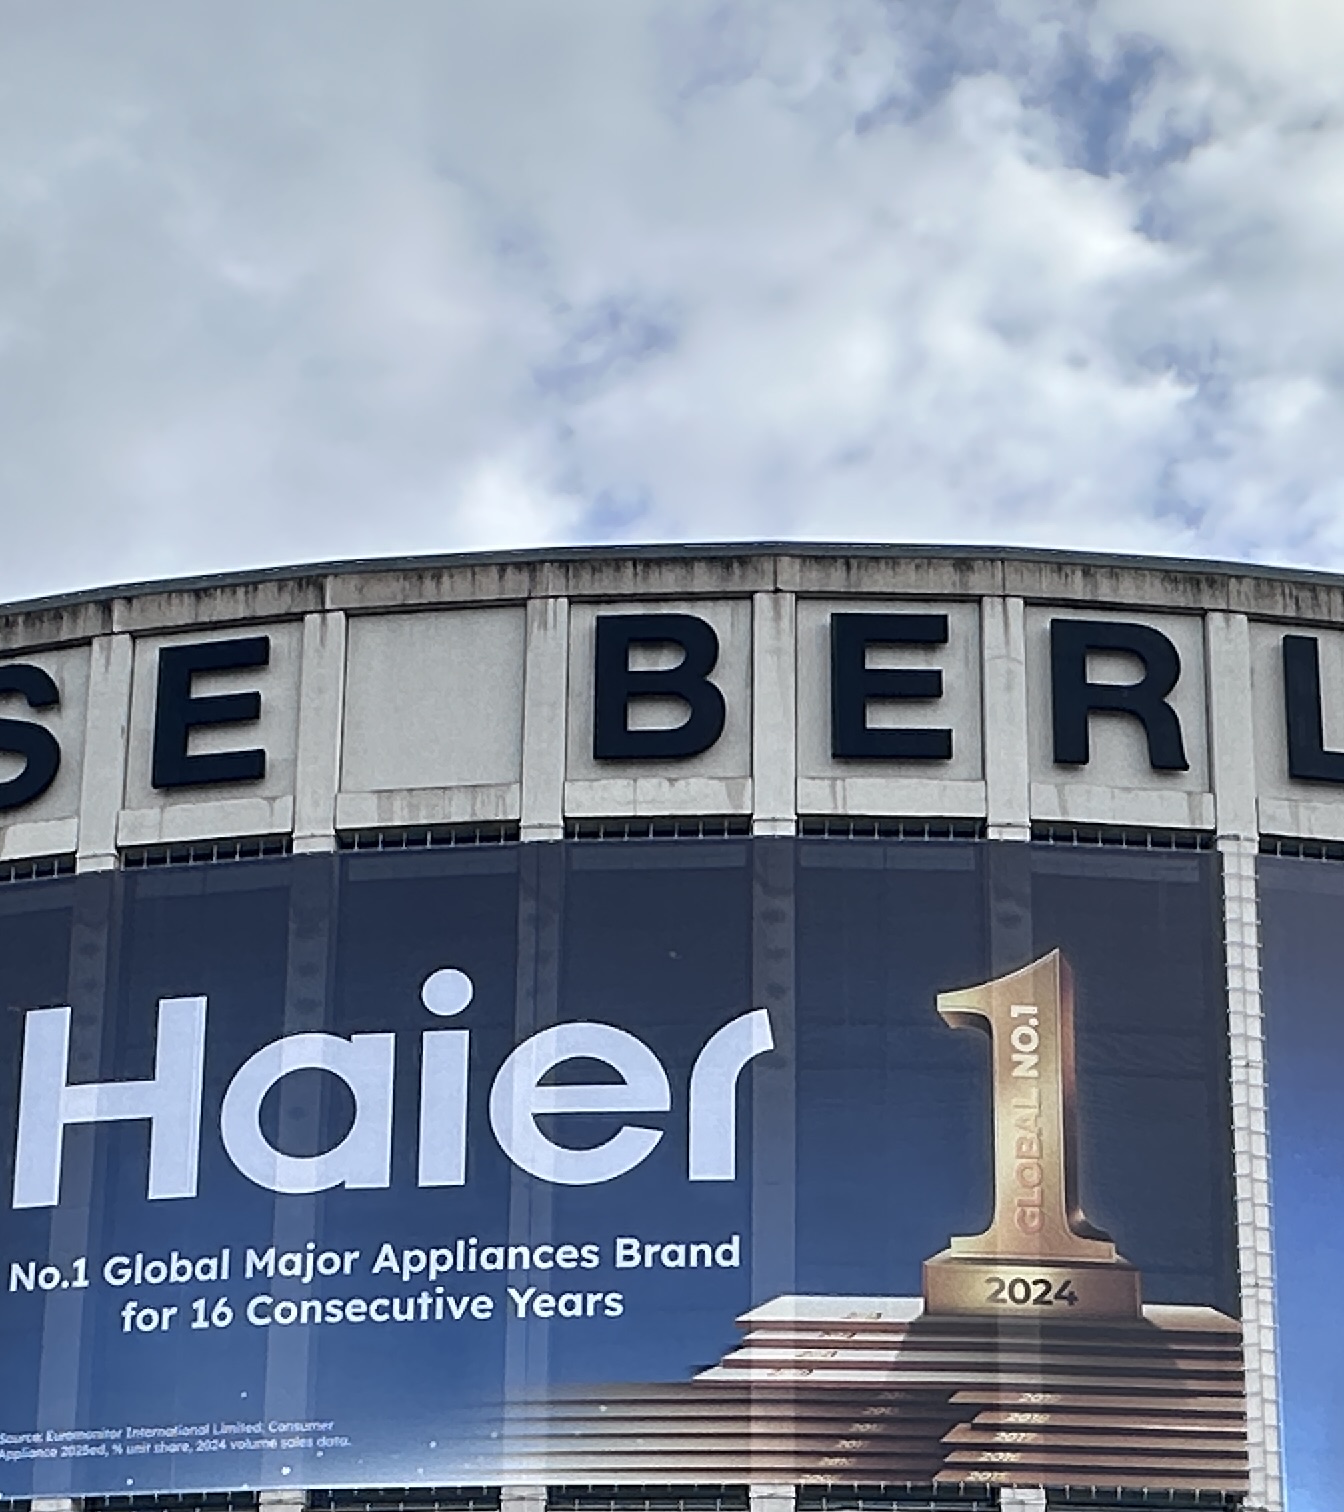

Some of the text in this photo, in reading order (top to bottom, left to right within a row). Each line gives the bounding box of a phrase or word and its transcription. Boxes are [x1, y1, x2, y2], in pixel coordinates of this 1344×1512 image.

[12, 969, 774, 1209] Haier
[1009, 1003, 1047, 1234] GLOBAL NO.1
[8, 1235, 741, 1293] No.1 Global Major Appliances Brand
[122, 1287, 624, 1332] for 16 Consecutive Years
[985, 1277, 1078, 1306] 2024
[127, 1421, 209, 1438] International
[268, 1420, 335, 1432] Consumer
[196, 1438, 226, 1451] 2024
[230, 1438, 277, 1449] volume
[281, 1436, 313, 1448] sales
